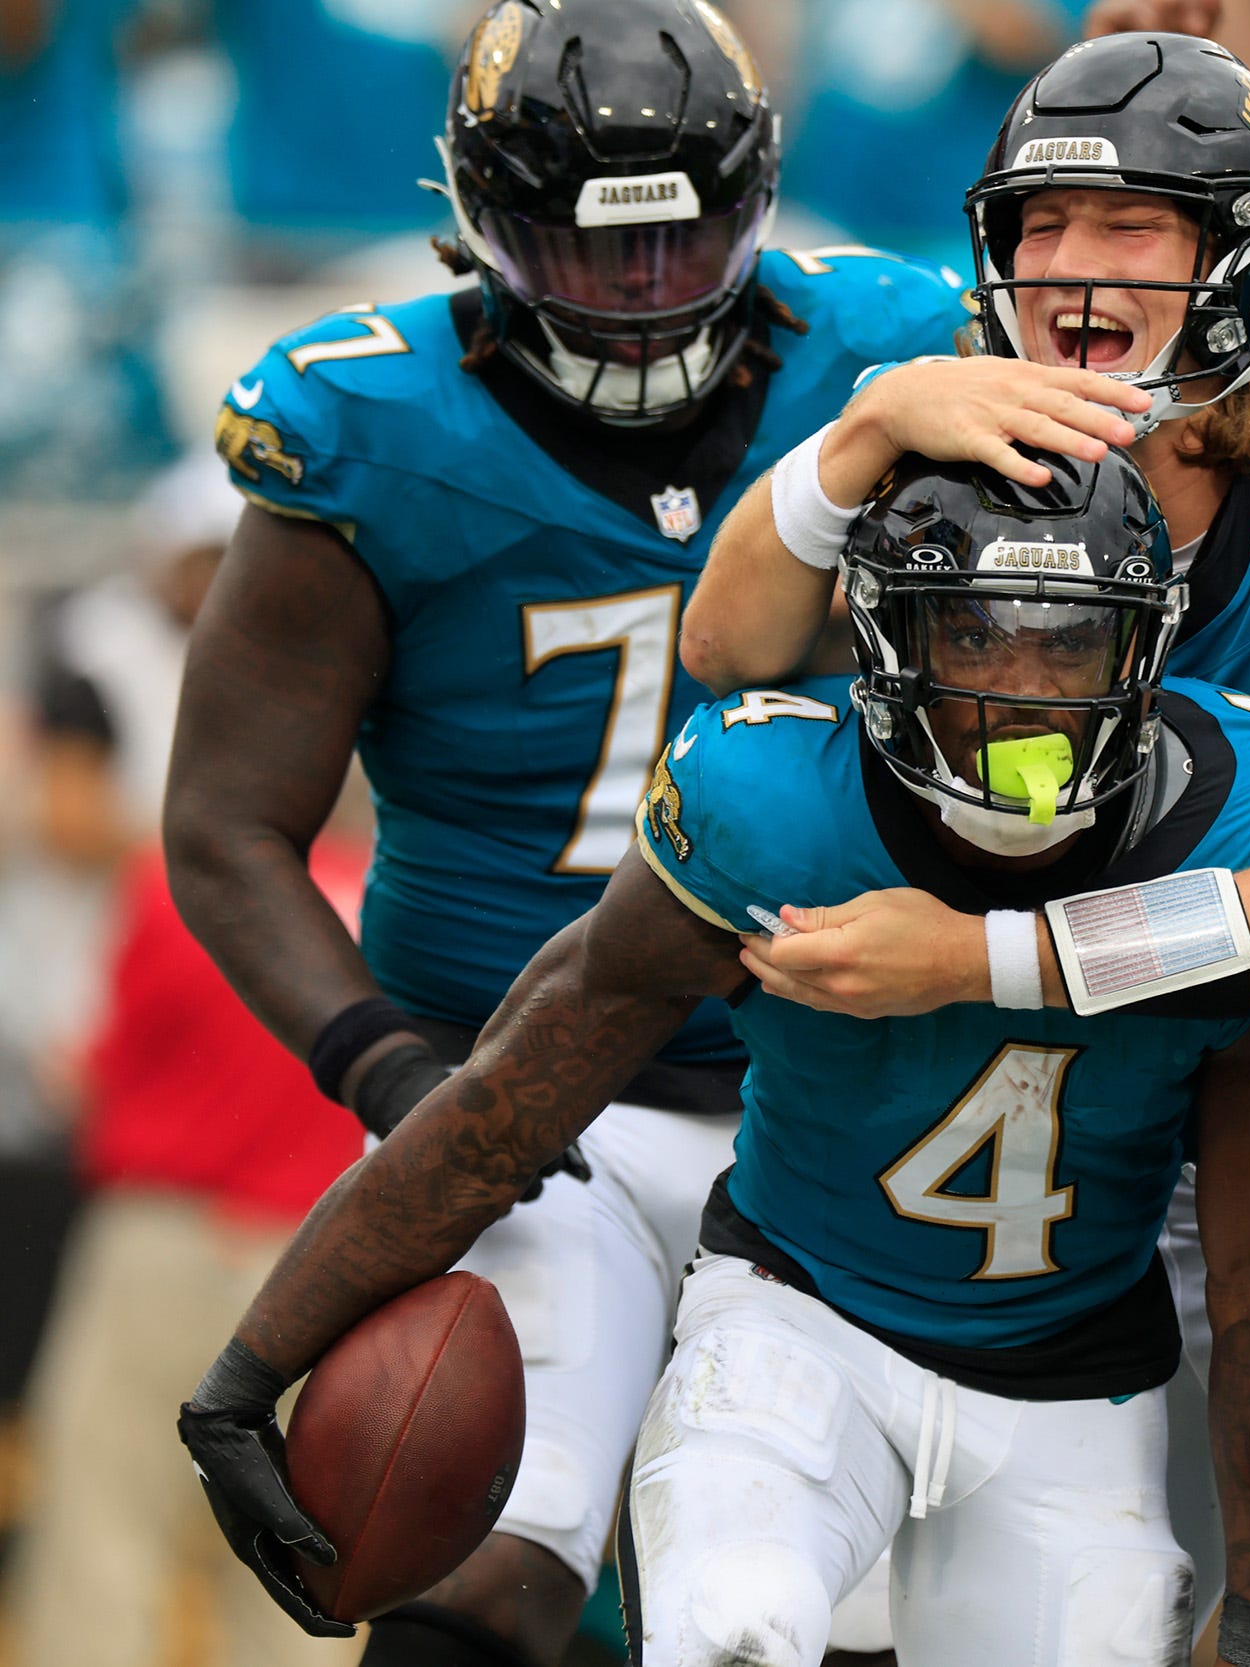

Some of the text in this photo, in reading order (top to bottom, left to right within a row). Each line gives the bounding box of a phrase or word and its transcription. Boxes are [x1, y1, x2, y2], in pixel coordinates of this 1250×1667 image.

[1024, 141, 1104, 163] JAGUARS
[597, 182, 679, 206] JAGUARS
[286, 304, 414, 379] 7
[993, 546, 1081, 571] JAGUARS
[721, 690, 840, 734] 4
[873, 1038, 1089, 1282] 4
